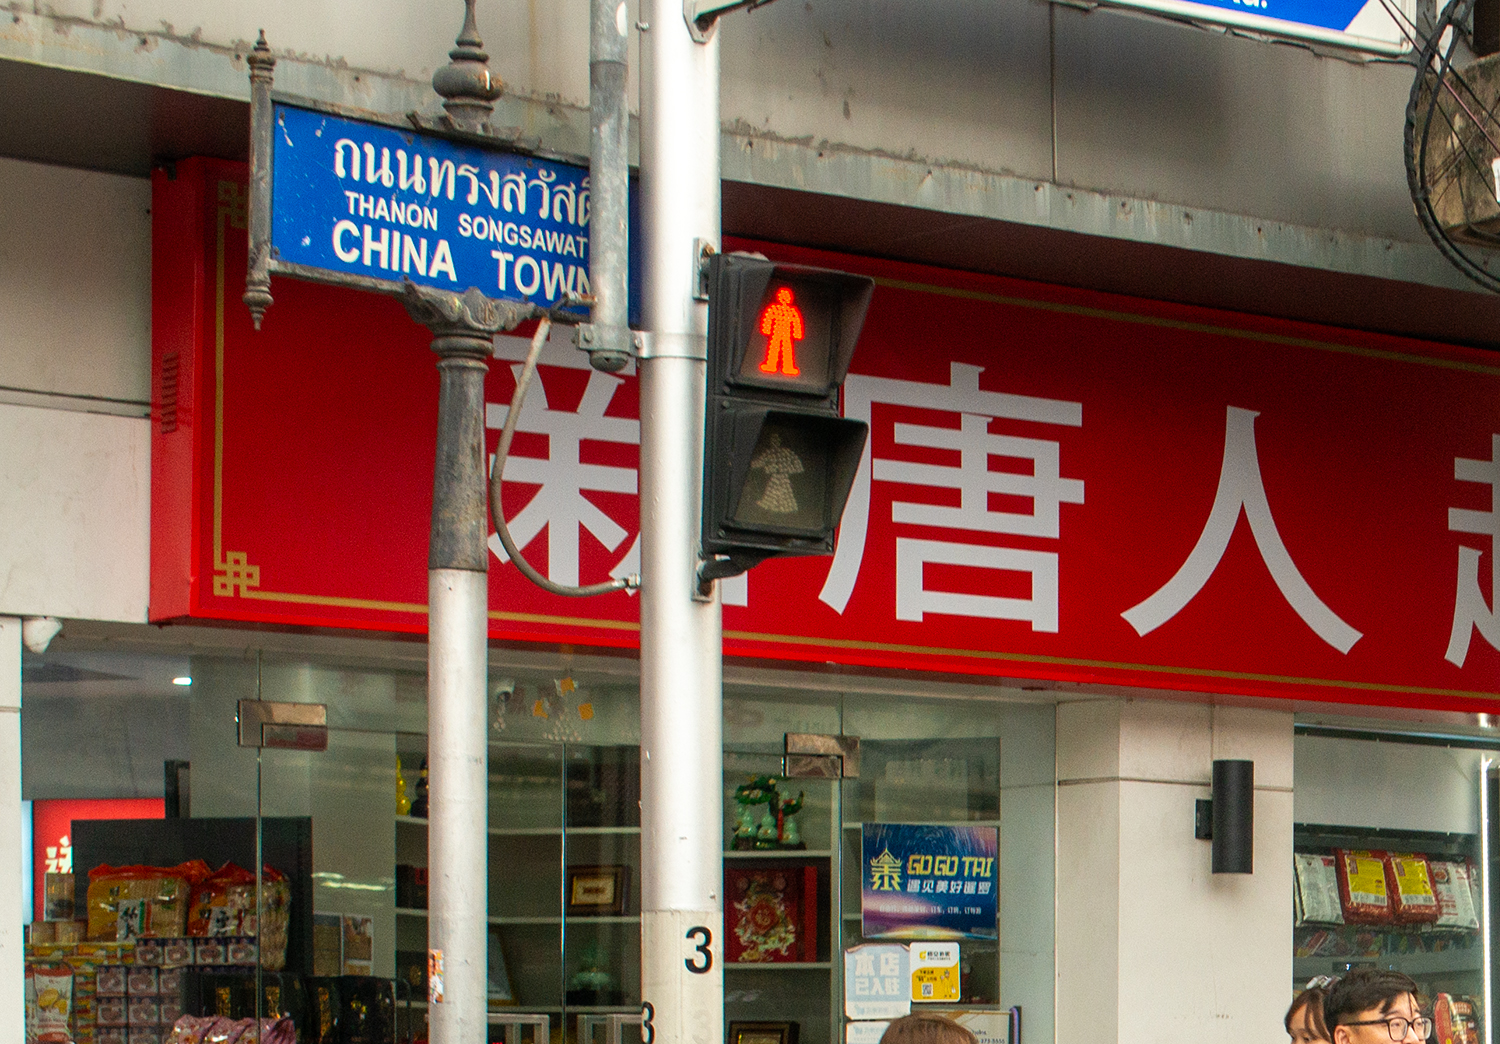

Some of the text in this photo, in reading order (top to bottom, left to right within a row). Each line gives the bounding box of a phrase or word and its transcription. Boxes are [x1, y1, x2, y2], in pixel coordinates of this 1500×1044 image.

[344, 190, 589, 259] THANON SONGSAWAT
[332, 219, 591, 301] CHINA TOWN
[684, 926, 714, 974] 3
[855, 952, 900, 977] 本店
